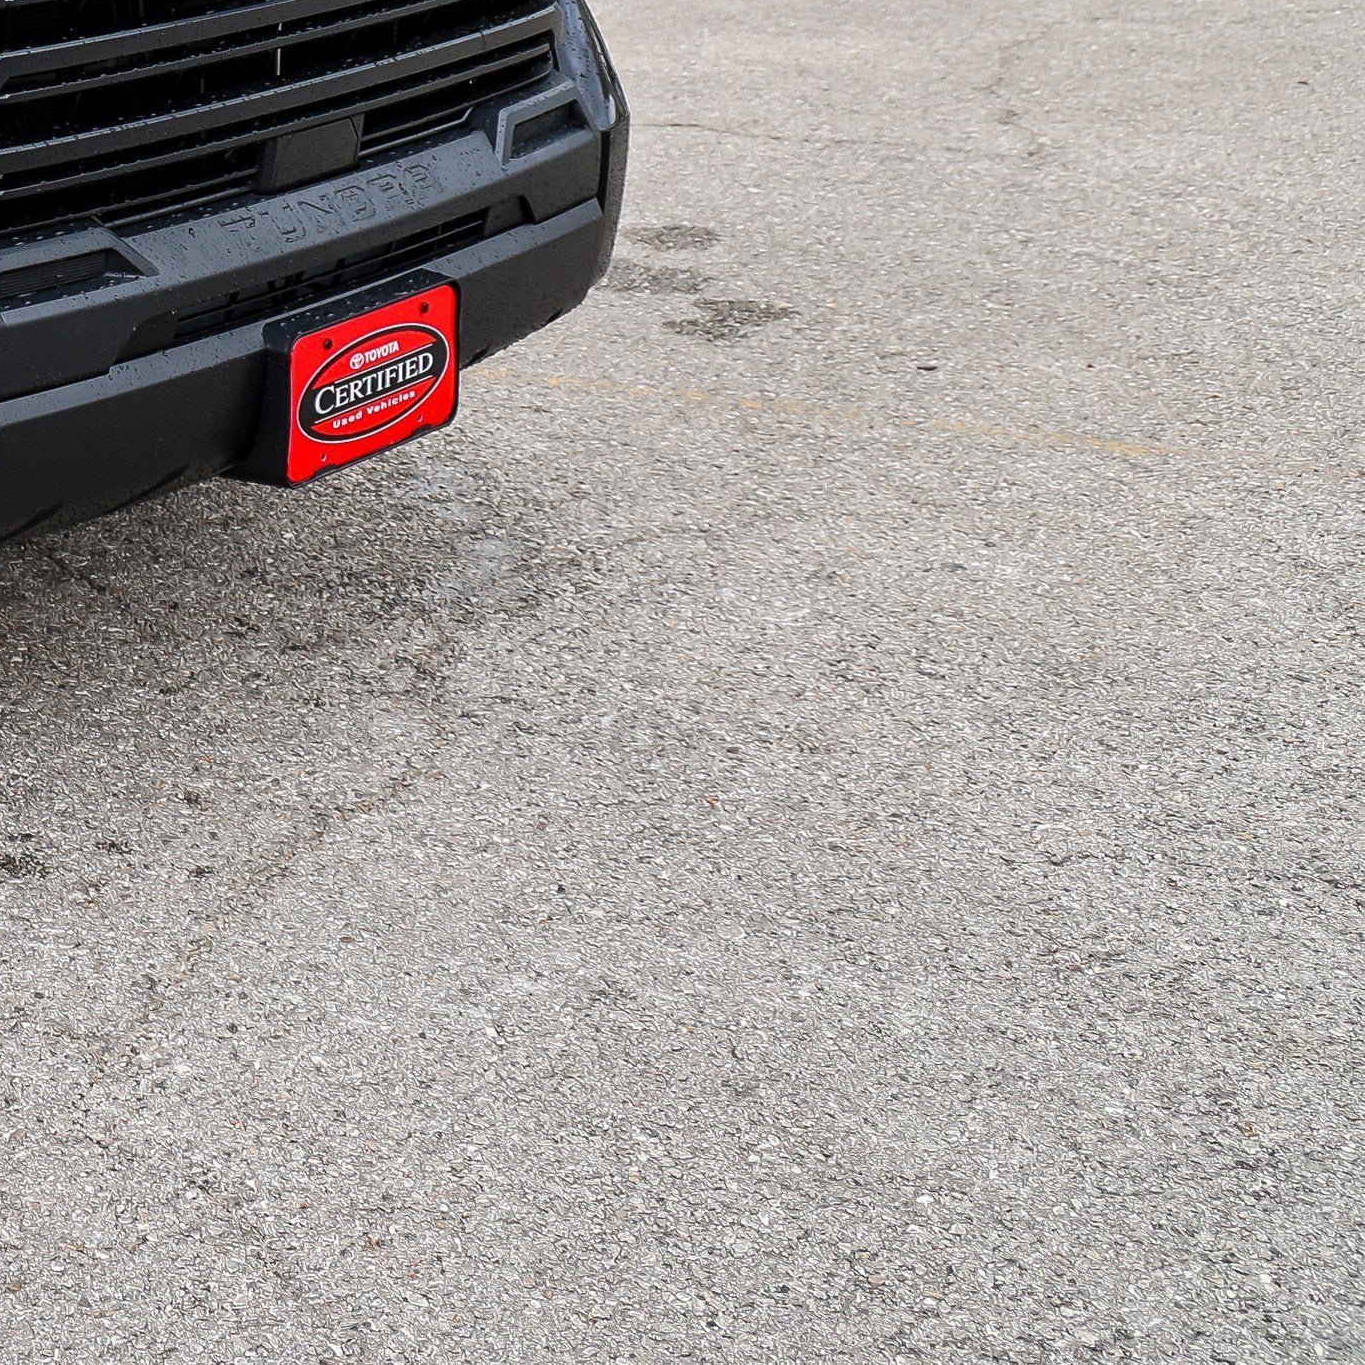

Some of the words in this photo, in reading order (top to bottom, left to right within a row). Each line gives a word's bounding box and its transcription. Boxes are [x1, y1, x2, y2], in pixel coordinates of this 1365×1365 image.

[363, 341, 400, 363] TOYOTA
[314, 352, 434, 415] CERTIFIED
[332, 410, 363, 429] Used
[366, 390, 416, 415] Vehicles
